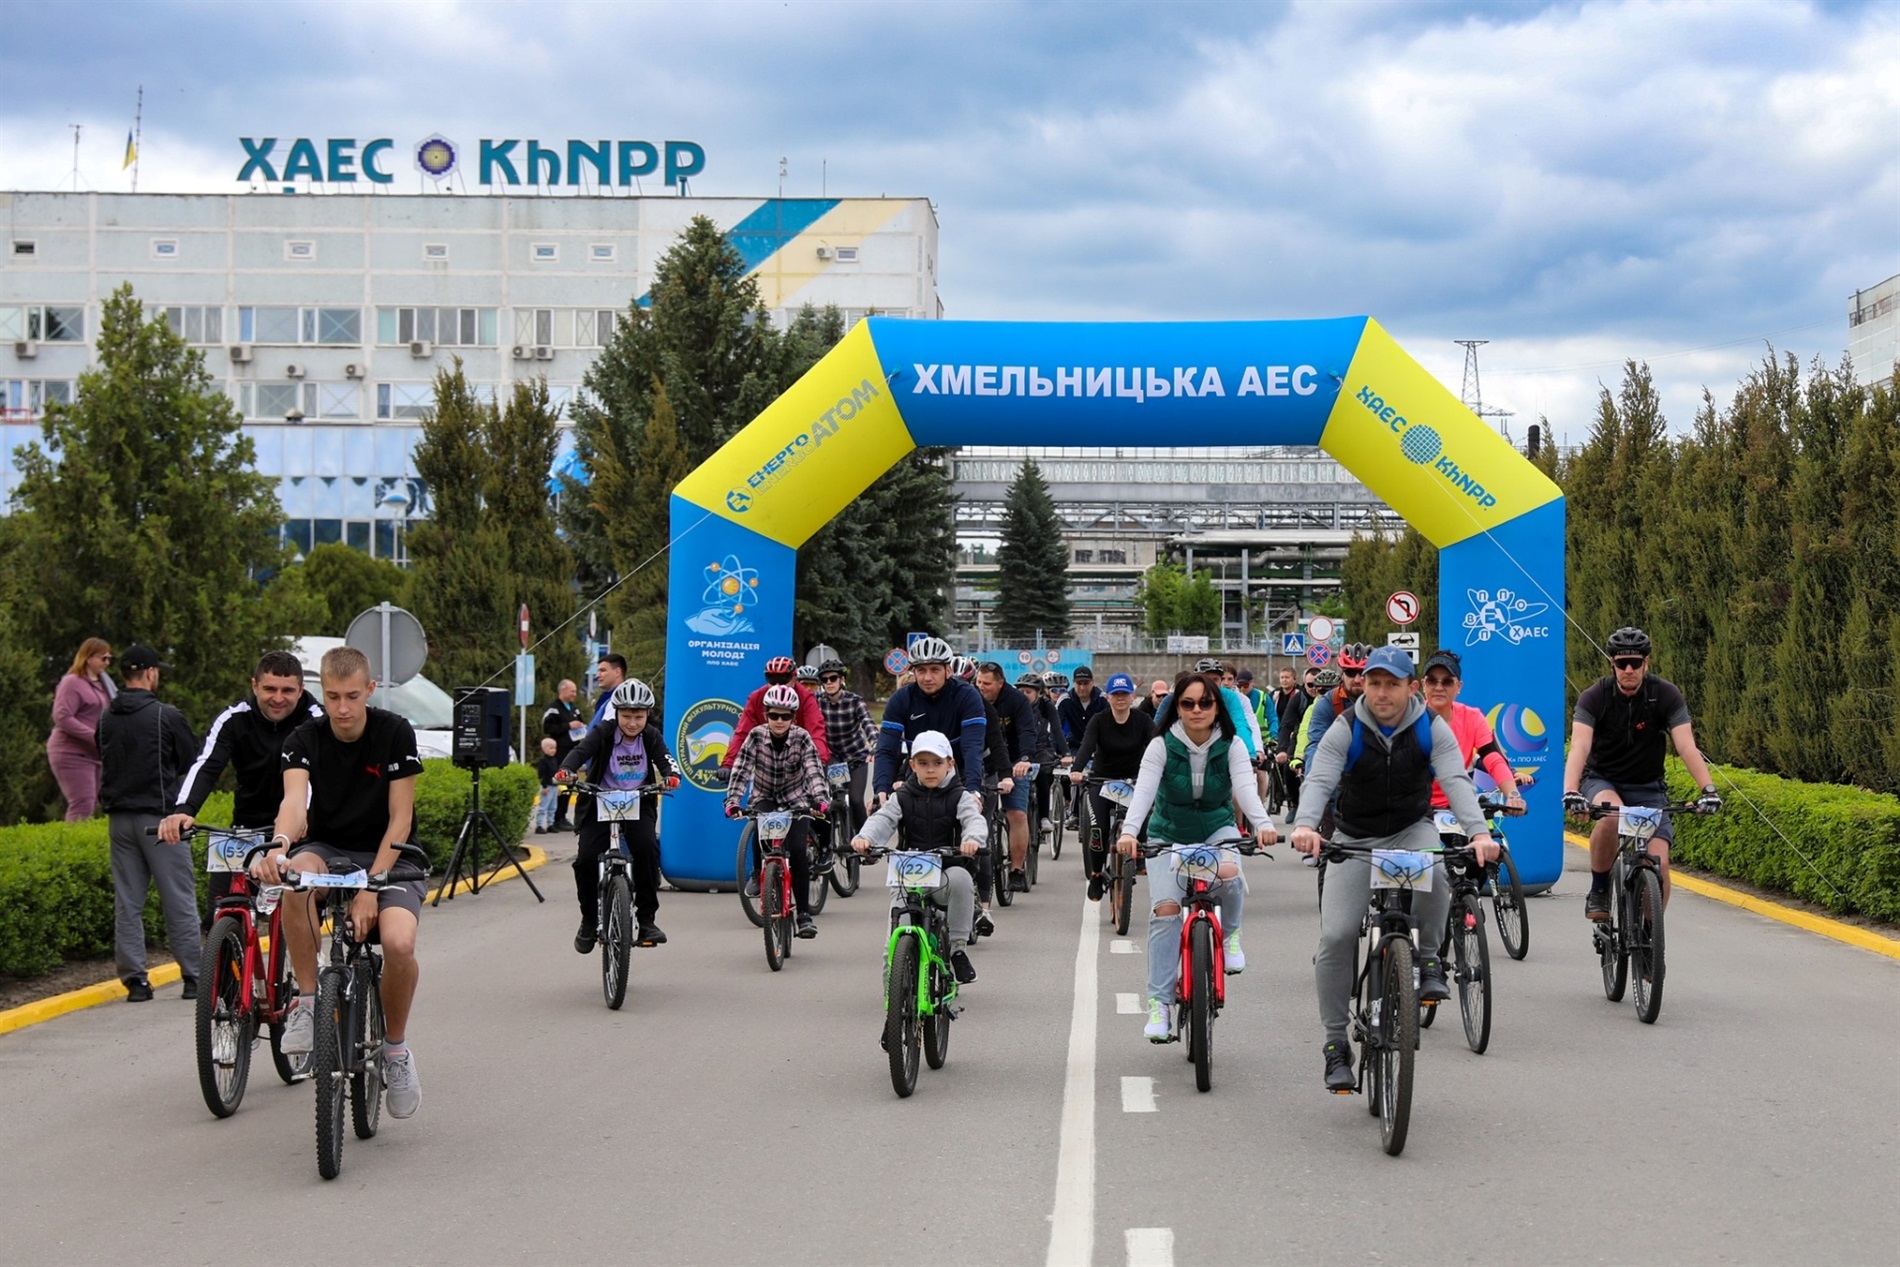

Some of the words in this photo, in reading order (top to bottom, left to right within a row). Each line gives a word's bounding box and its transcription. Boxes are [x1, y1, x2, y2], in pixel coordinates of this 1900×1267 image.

[236, 137, 394, 183] ХАЕС
[479, 138, 706, 187] KhNPP
[912, 363, 1226, 403] ХМЕЛЬНИЦЬКА
[1237, 365, 1318, 397] АЕС
[1356, 385, 1407, 433] ХАЕС
[1434, 455, 1496, 508] KhNPP
[688, 640, 760, 651] ОРГАНІЗАЦІЯ
[702, 650, 745, 660] МОЛОДІ
[687, 702, 743, 722] ФІЗКУЛЬТУРНО-С
[612, 801, 626, 810] 58
[769, 821, 782, 830] 56
[226, 846, 245, 858] 53
[905, 863, 923, 875] 22
[1393, 866, 1410, 878] 21
